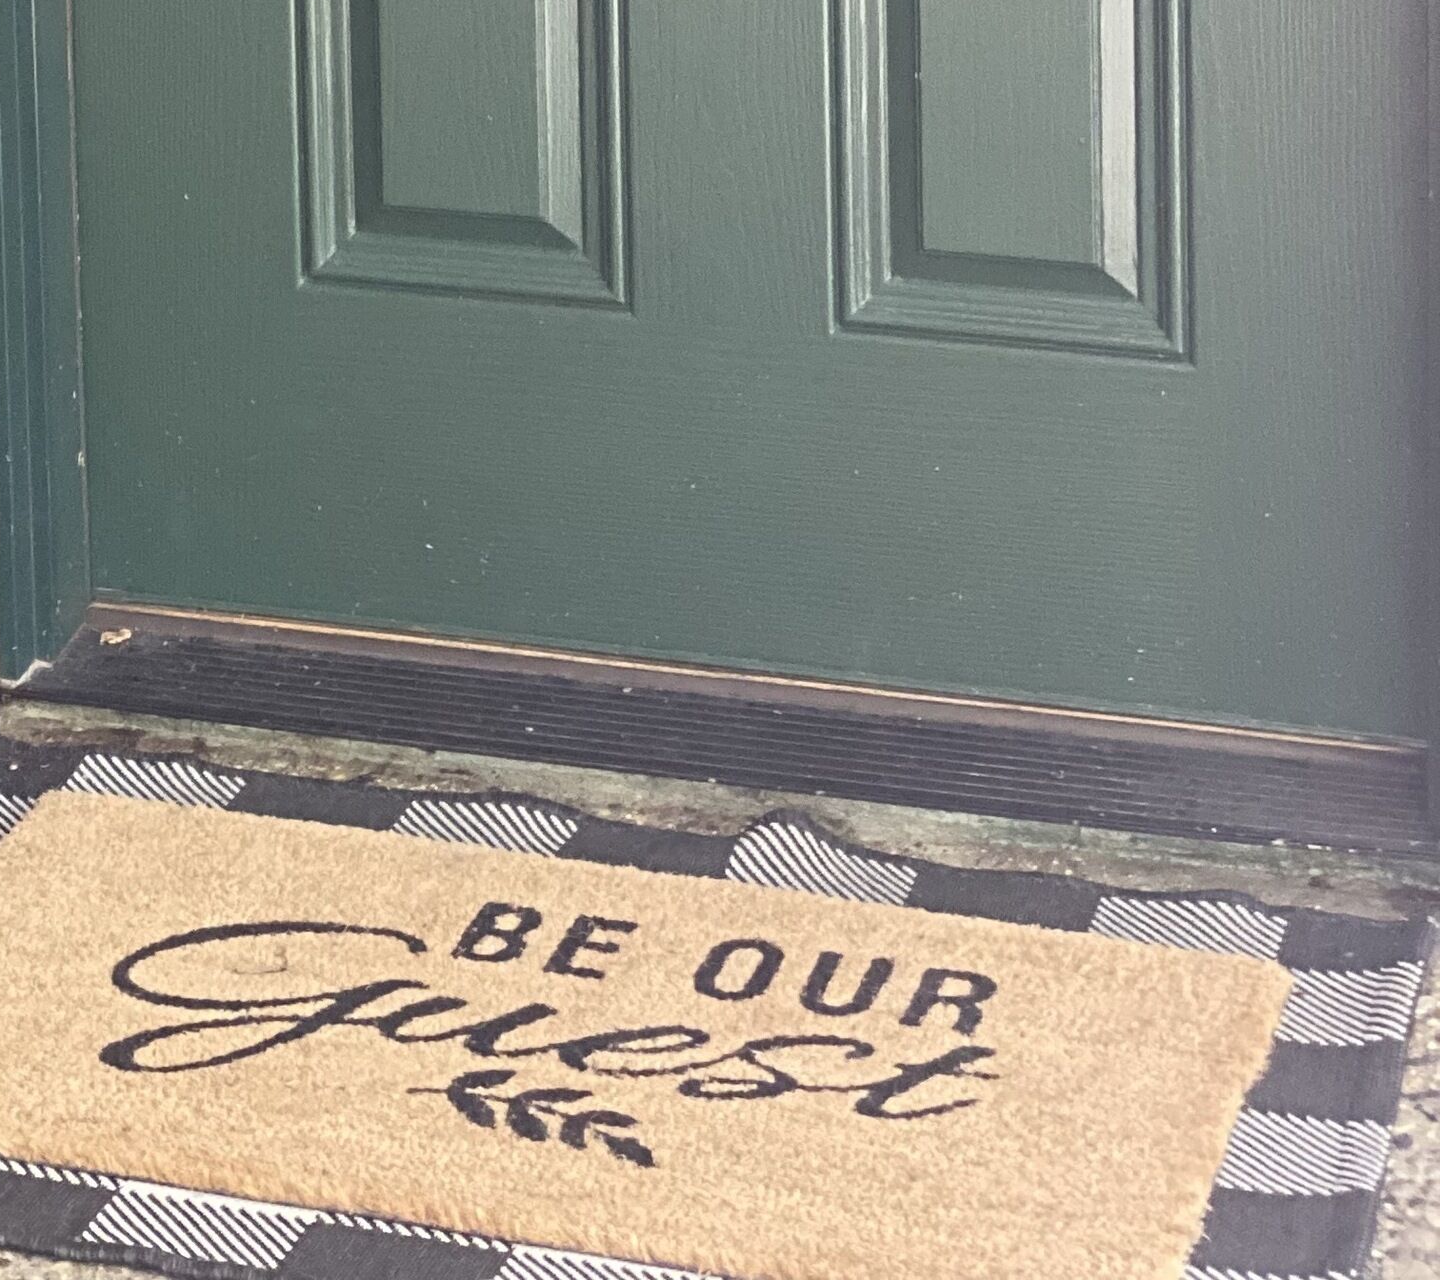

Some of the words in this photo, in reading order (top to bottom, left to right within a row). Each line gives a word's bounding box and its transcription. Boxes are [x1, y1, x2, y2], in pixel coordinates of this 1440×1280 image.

[98, 921, 1000, 1120] Guest
[450, 902, 638, 980] BE
[694, 939, 997, 1037] OUR
